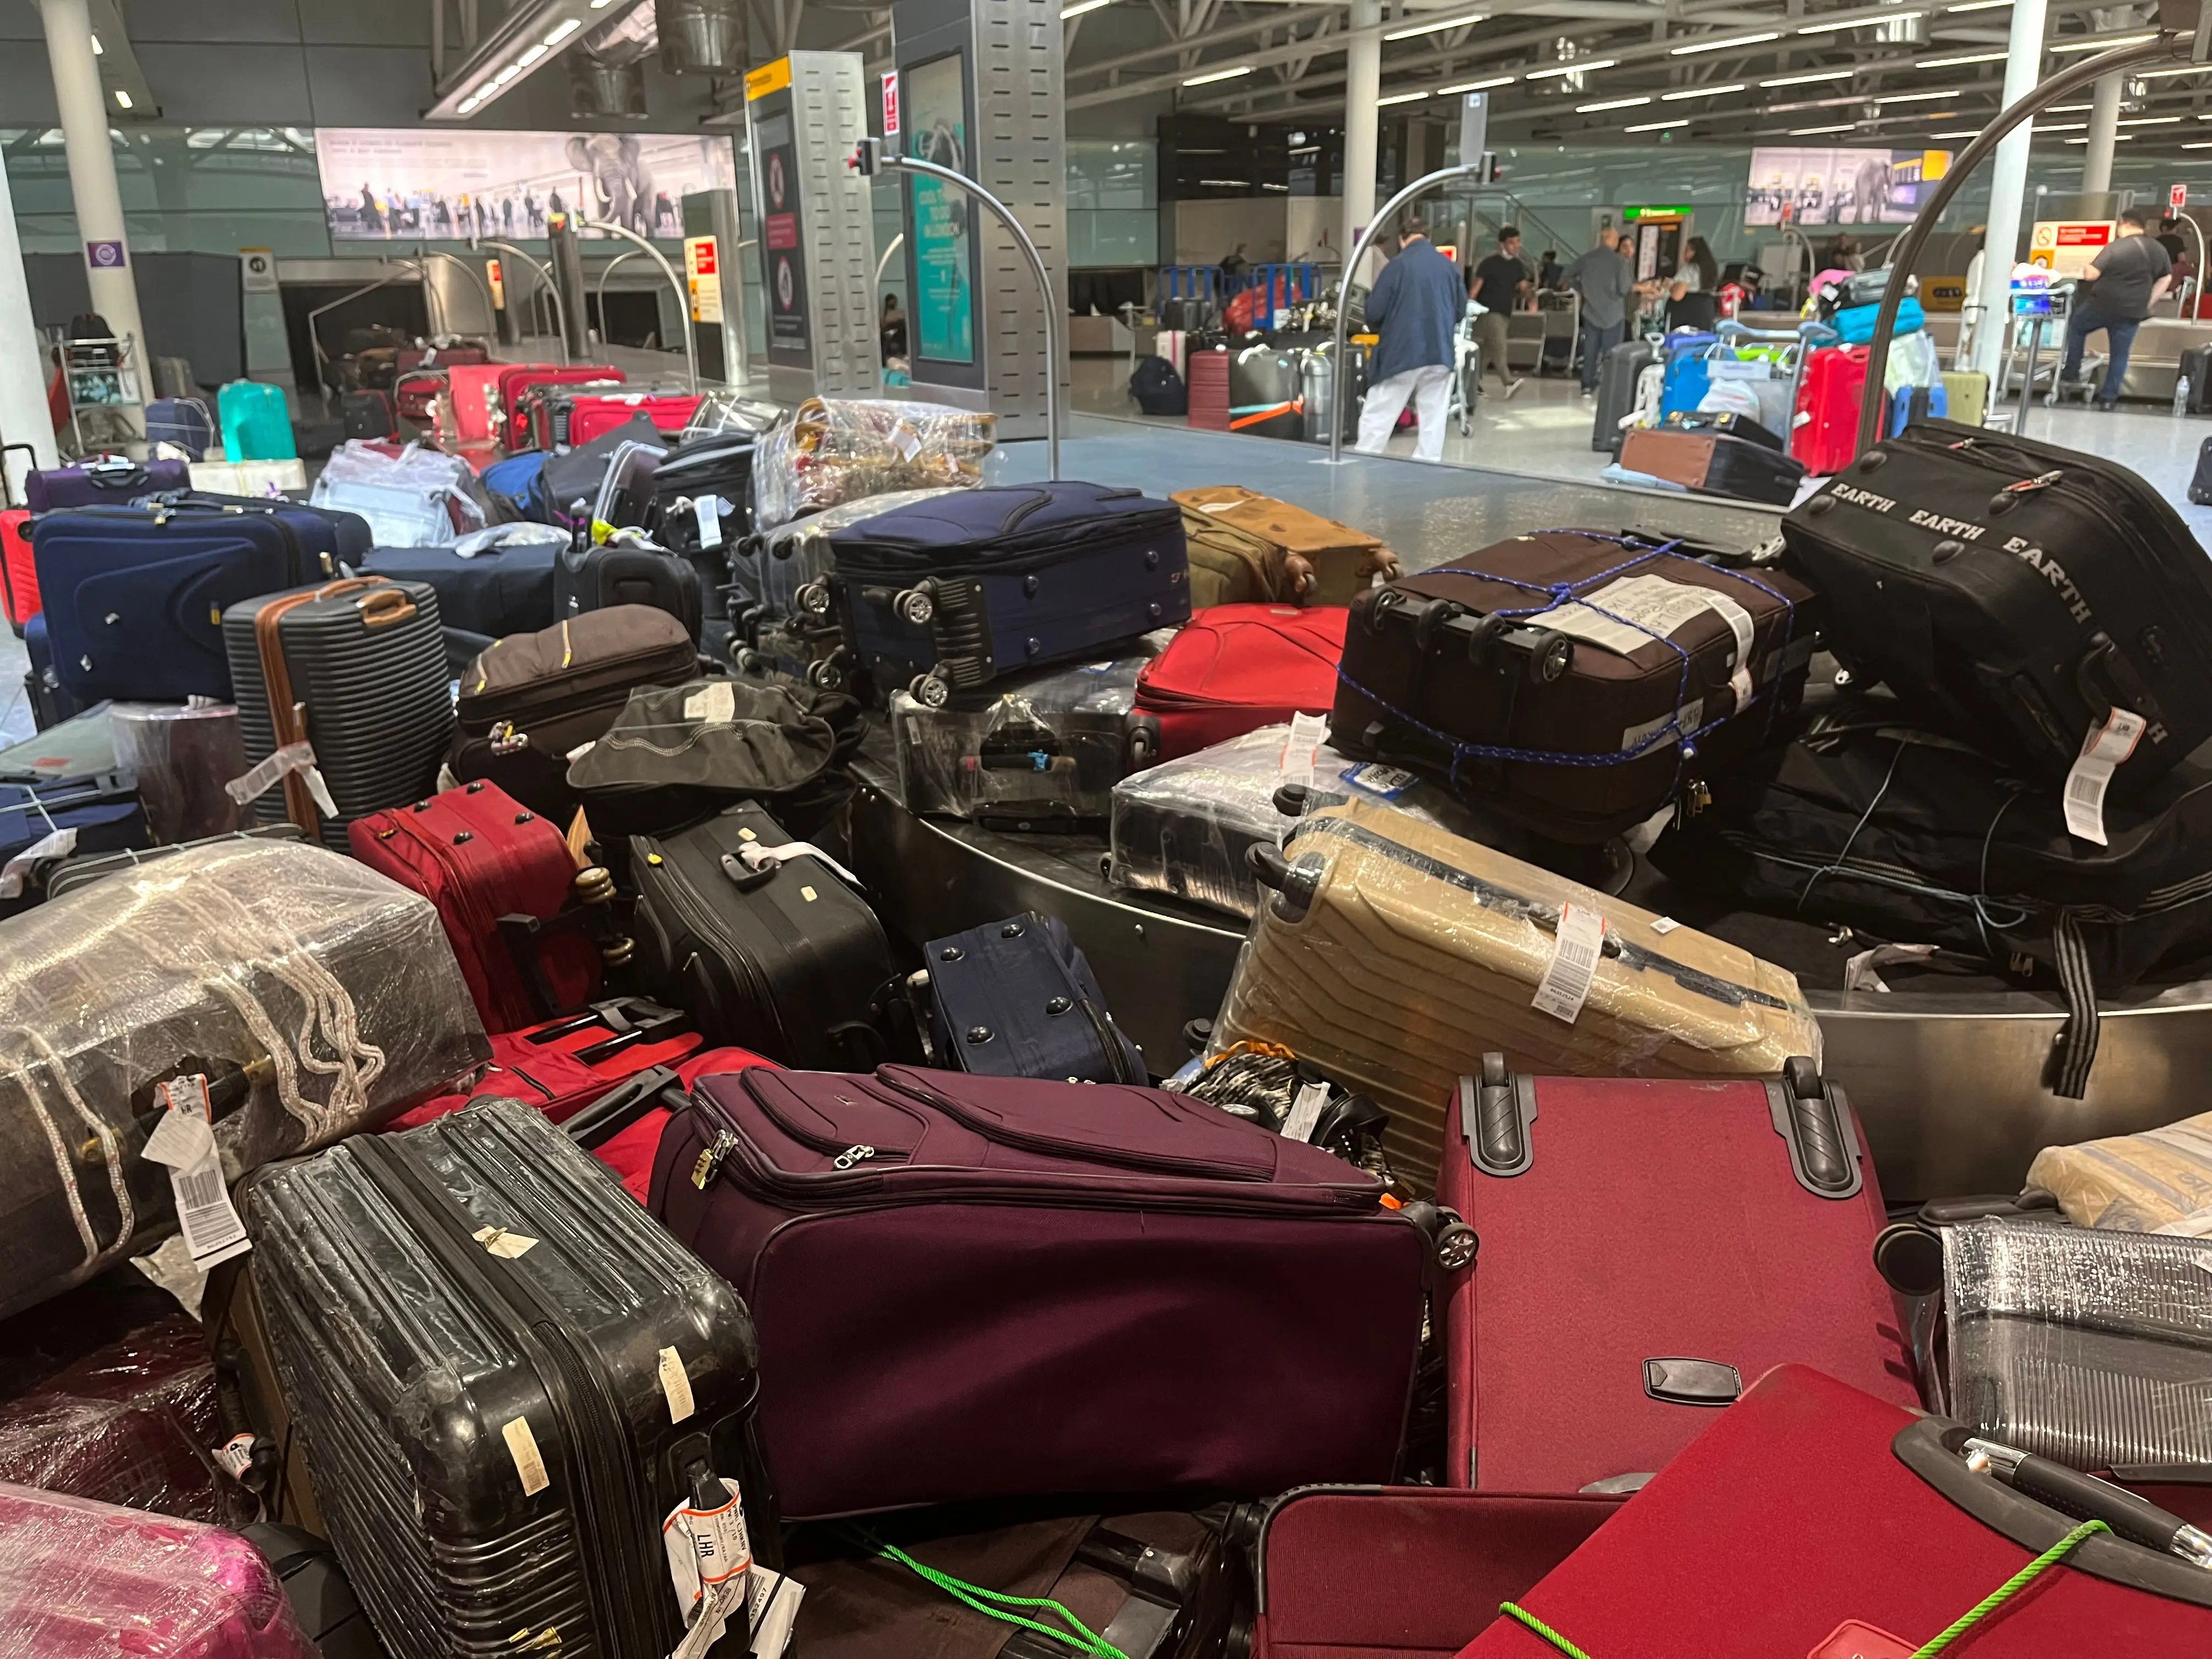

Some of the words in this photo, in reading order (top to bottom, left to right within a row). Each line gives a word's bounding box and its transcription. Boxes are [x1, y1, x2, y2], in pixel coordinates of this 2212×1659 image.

[1831, 483, 1896, 512] EARTH
[1909, 510, 1986, 540] EARTH
[2003, 537, 2092, 624] EARTH
[697, 1534, 714, 1558] LHR
